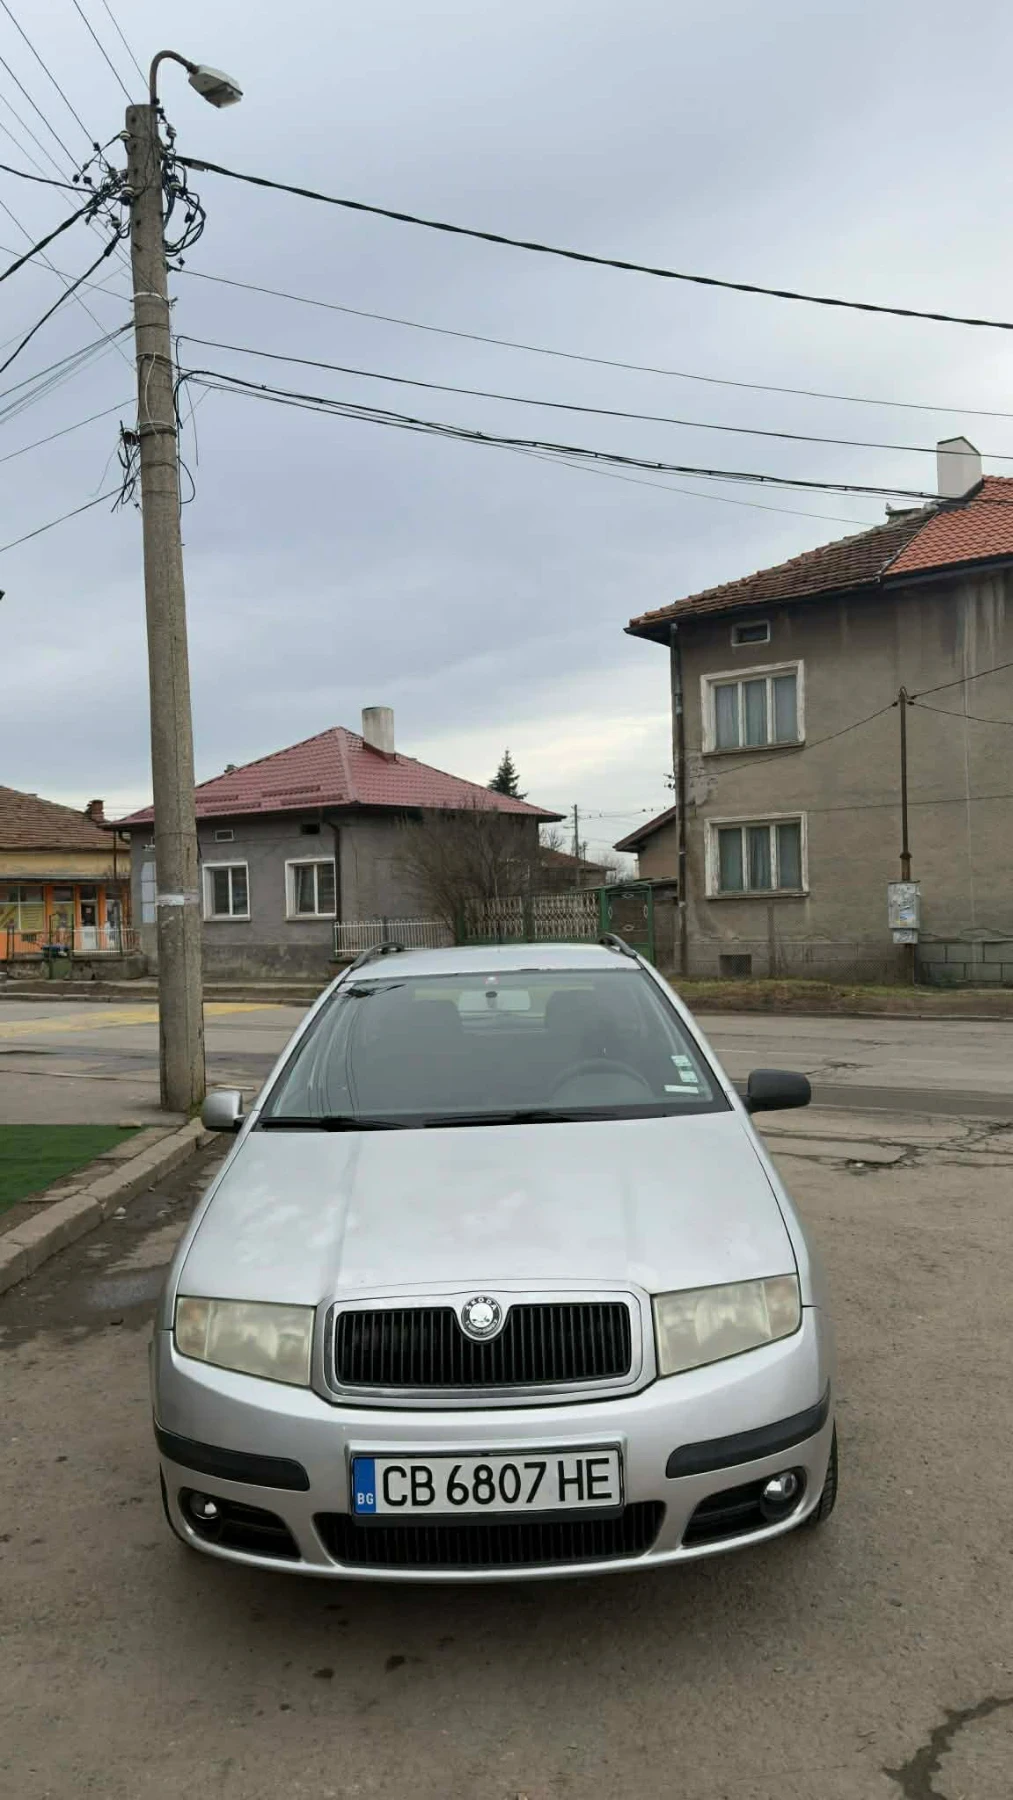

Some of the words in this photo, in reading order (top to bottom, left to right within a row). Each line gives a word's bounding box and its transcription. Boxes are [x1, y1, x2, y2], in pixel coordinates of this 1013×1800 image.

[382, 1465, 436, 1507] CB
[446, 1461, 547, 1506] 6807
[557, 1457, 612, 1502] HE
[357, 1492, 374, 1505] BG
